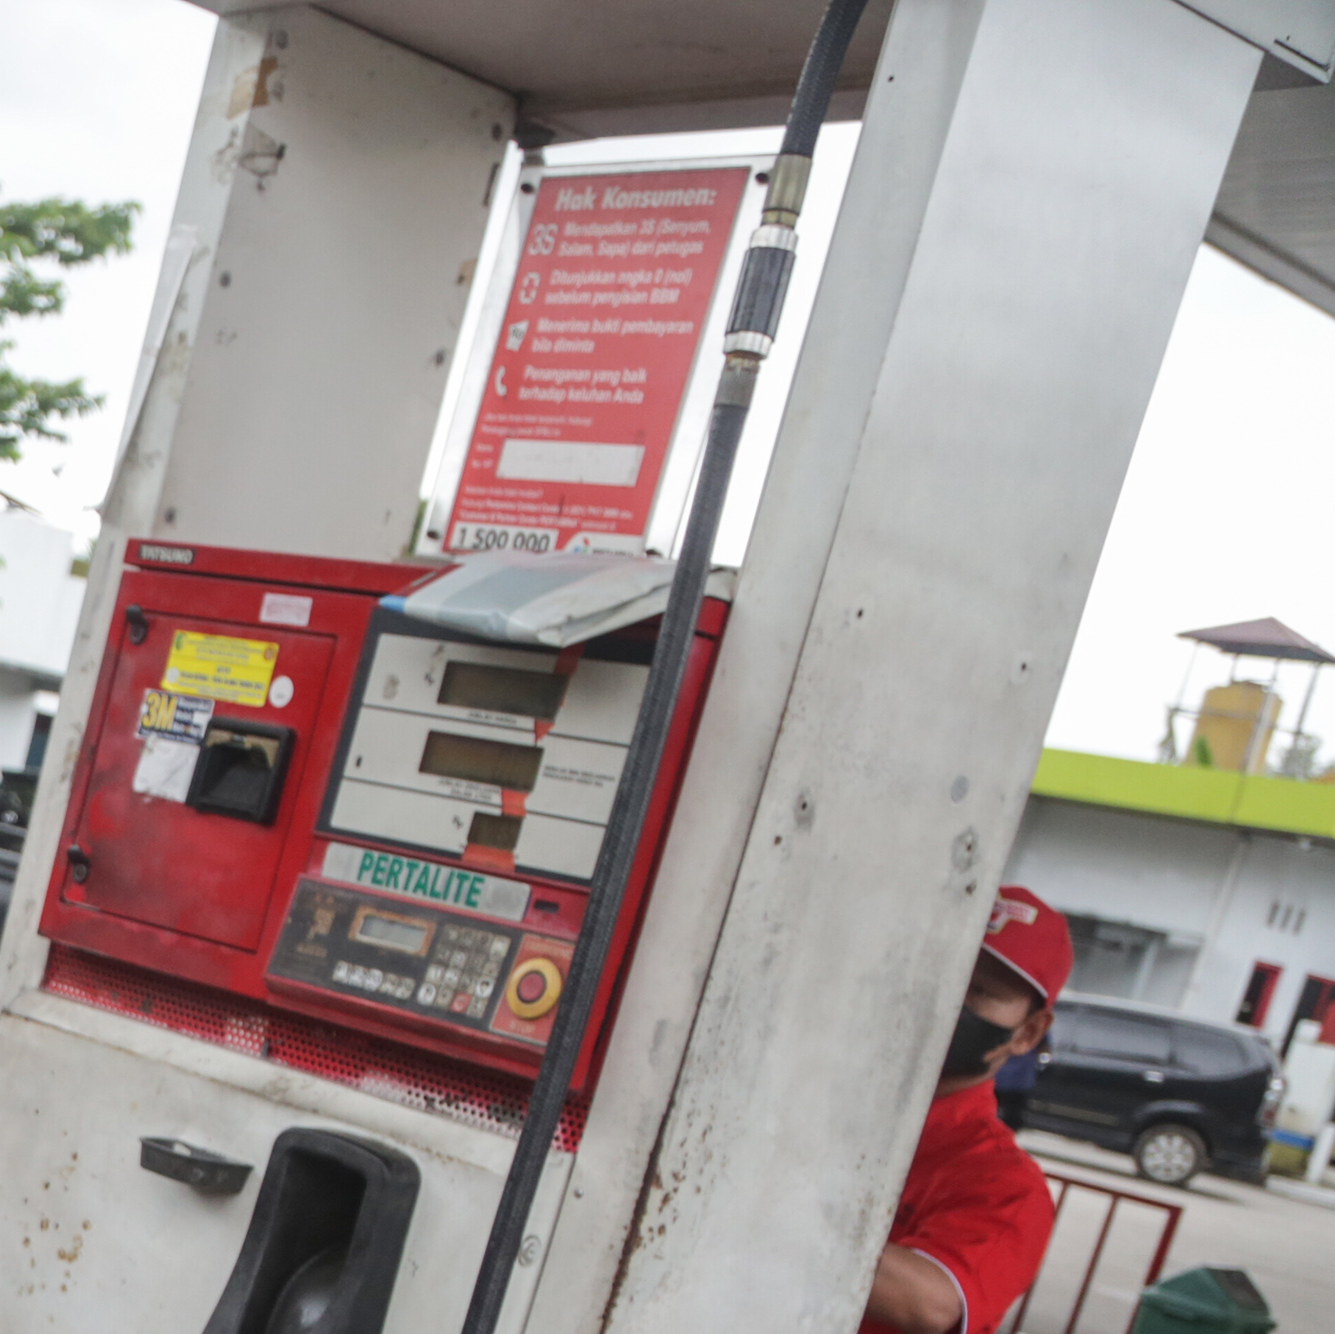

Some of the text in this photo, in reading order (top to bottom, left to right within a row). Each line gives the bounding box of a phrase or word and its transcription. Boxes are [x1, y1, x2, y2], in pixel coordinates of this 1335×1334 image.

[555, 186, 717, 211] Hak Konsumen:
[564, 221, 637, 238] Mendapatkan
[632, 240, 654, 255] dari
[655, 240, 704, 258] petugas
[617, 270, 652, 288] angka
[545, 289, 592, 305] sebelum
[592, 289, 649, 308] pengisian
[536, 317, 694, 337] Menerima bukti pembayaran
[554, 337, 595, 353] diminta
[523, 365, 647, 387] Penanganan yang baik
[519, 386, 645, 405] terhadap keluhan Anda
[142, 692, 178, 731] 3M
[357, 851, 485, 909] PERTALITE
